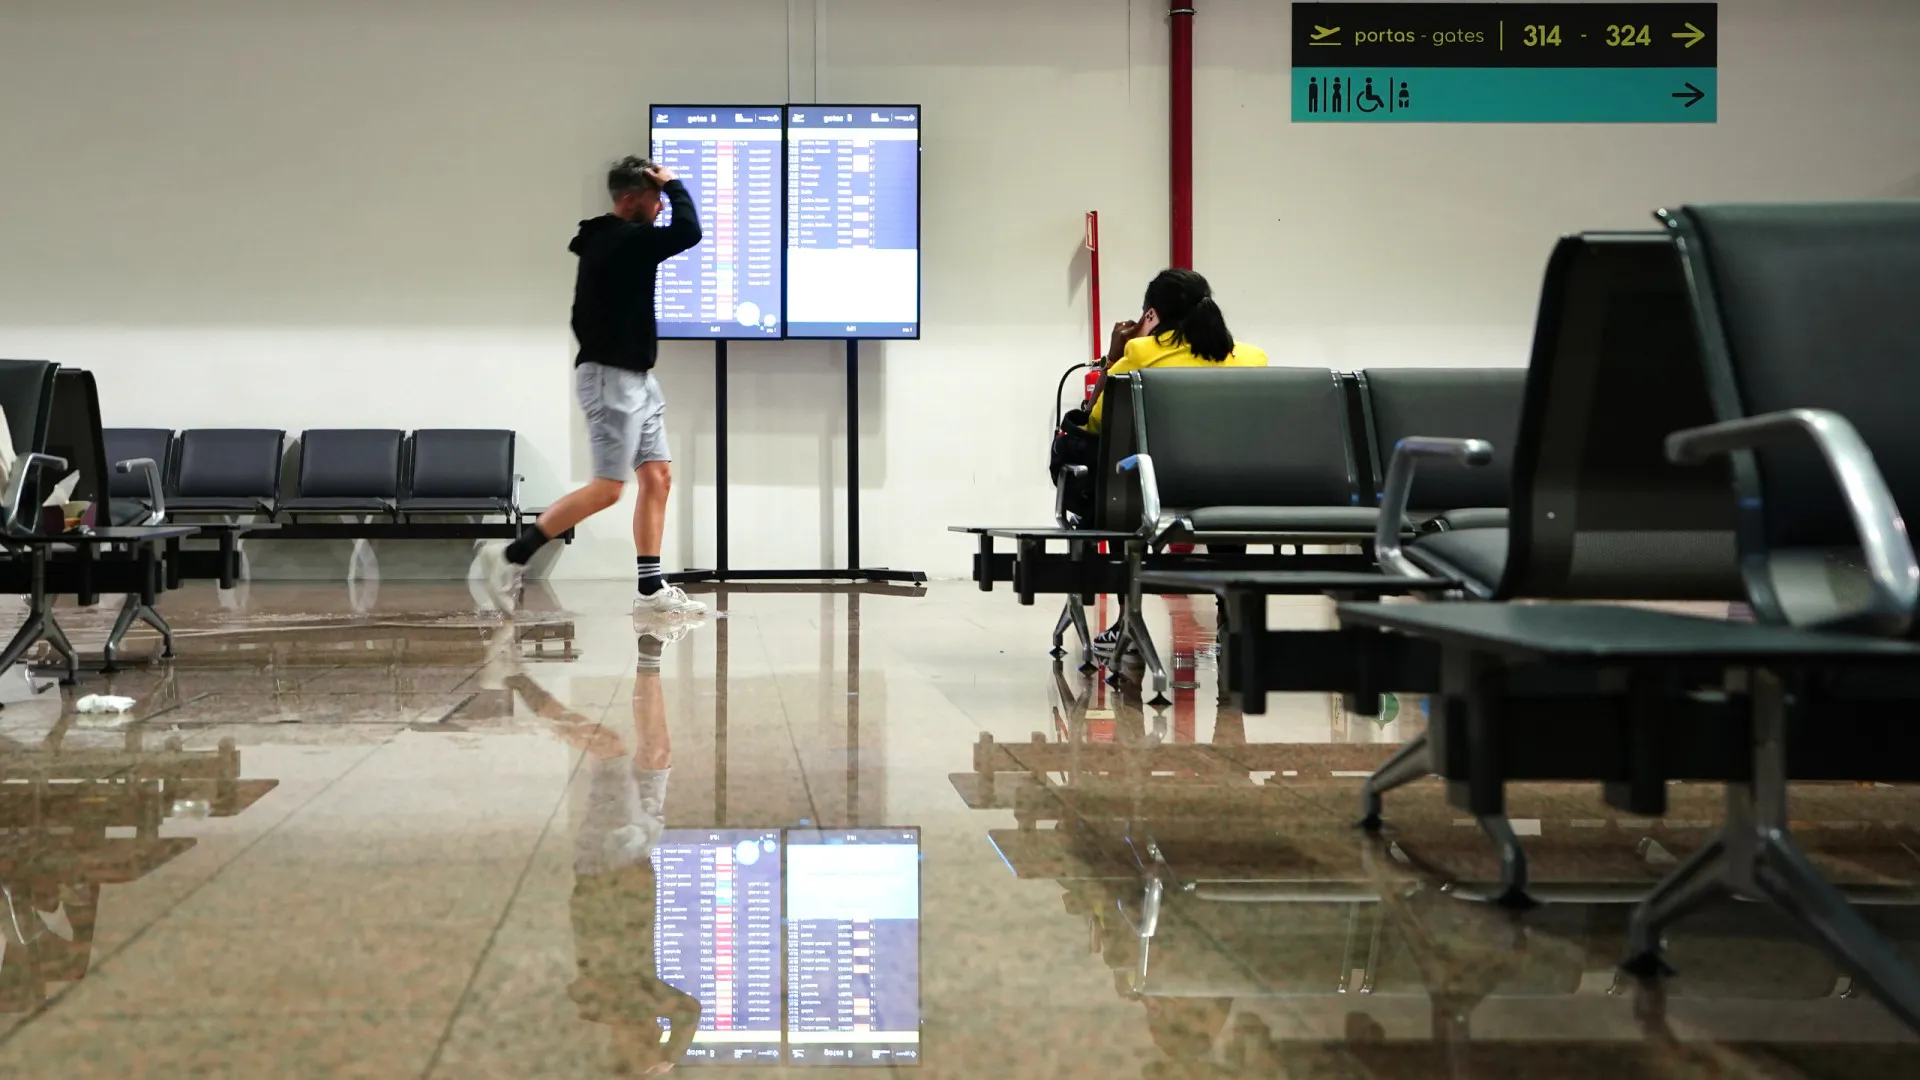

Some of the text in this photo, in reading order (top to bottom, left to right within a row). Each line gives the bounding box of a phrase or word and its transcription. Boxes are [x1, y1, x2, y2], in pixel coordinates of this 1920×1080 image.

[1355, 28, 1415, 46] portas
[1432, 28, 1484, 46] gates
[1523, 24, 1562, 47] 314
[1605, 24, 1652, 47] 324
